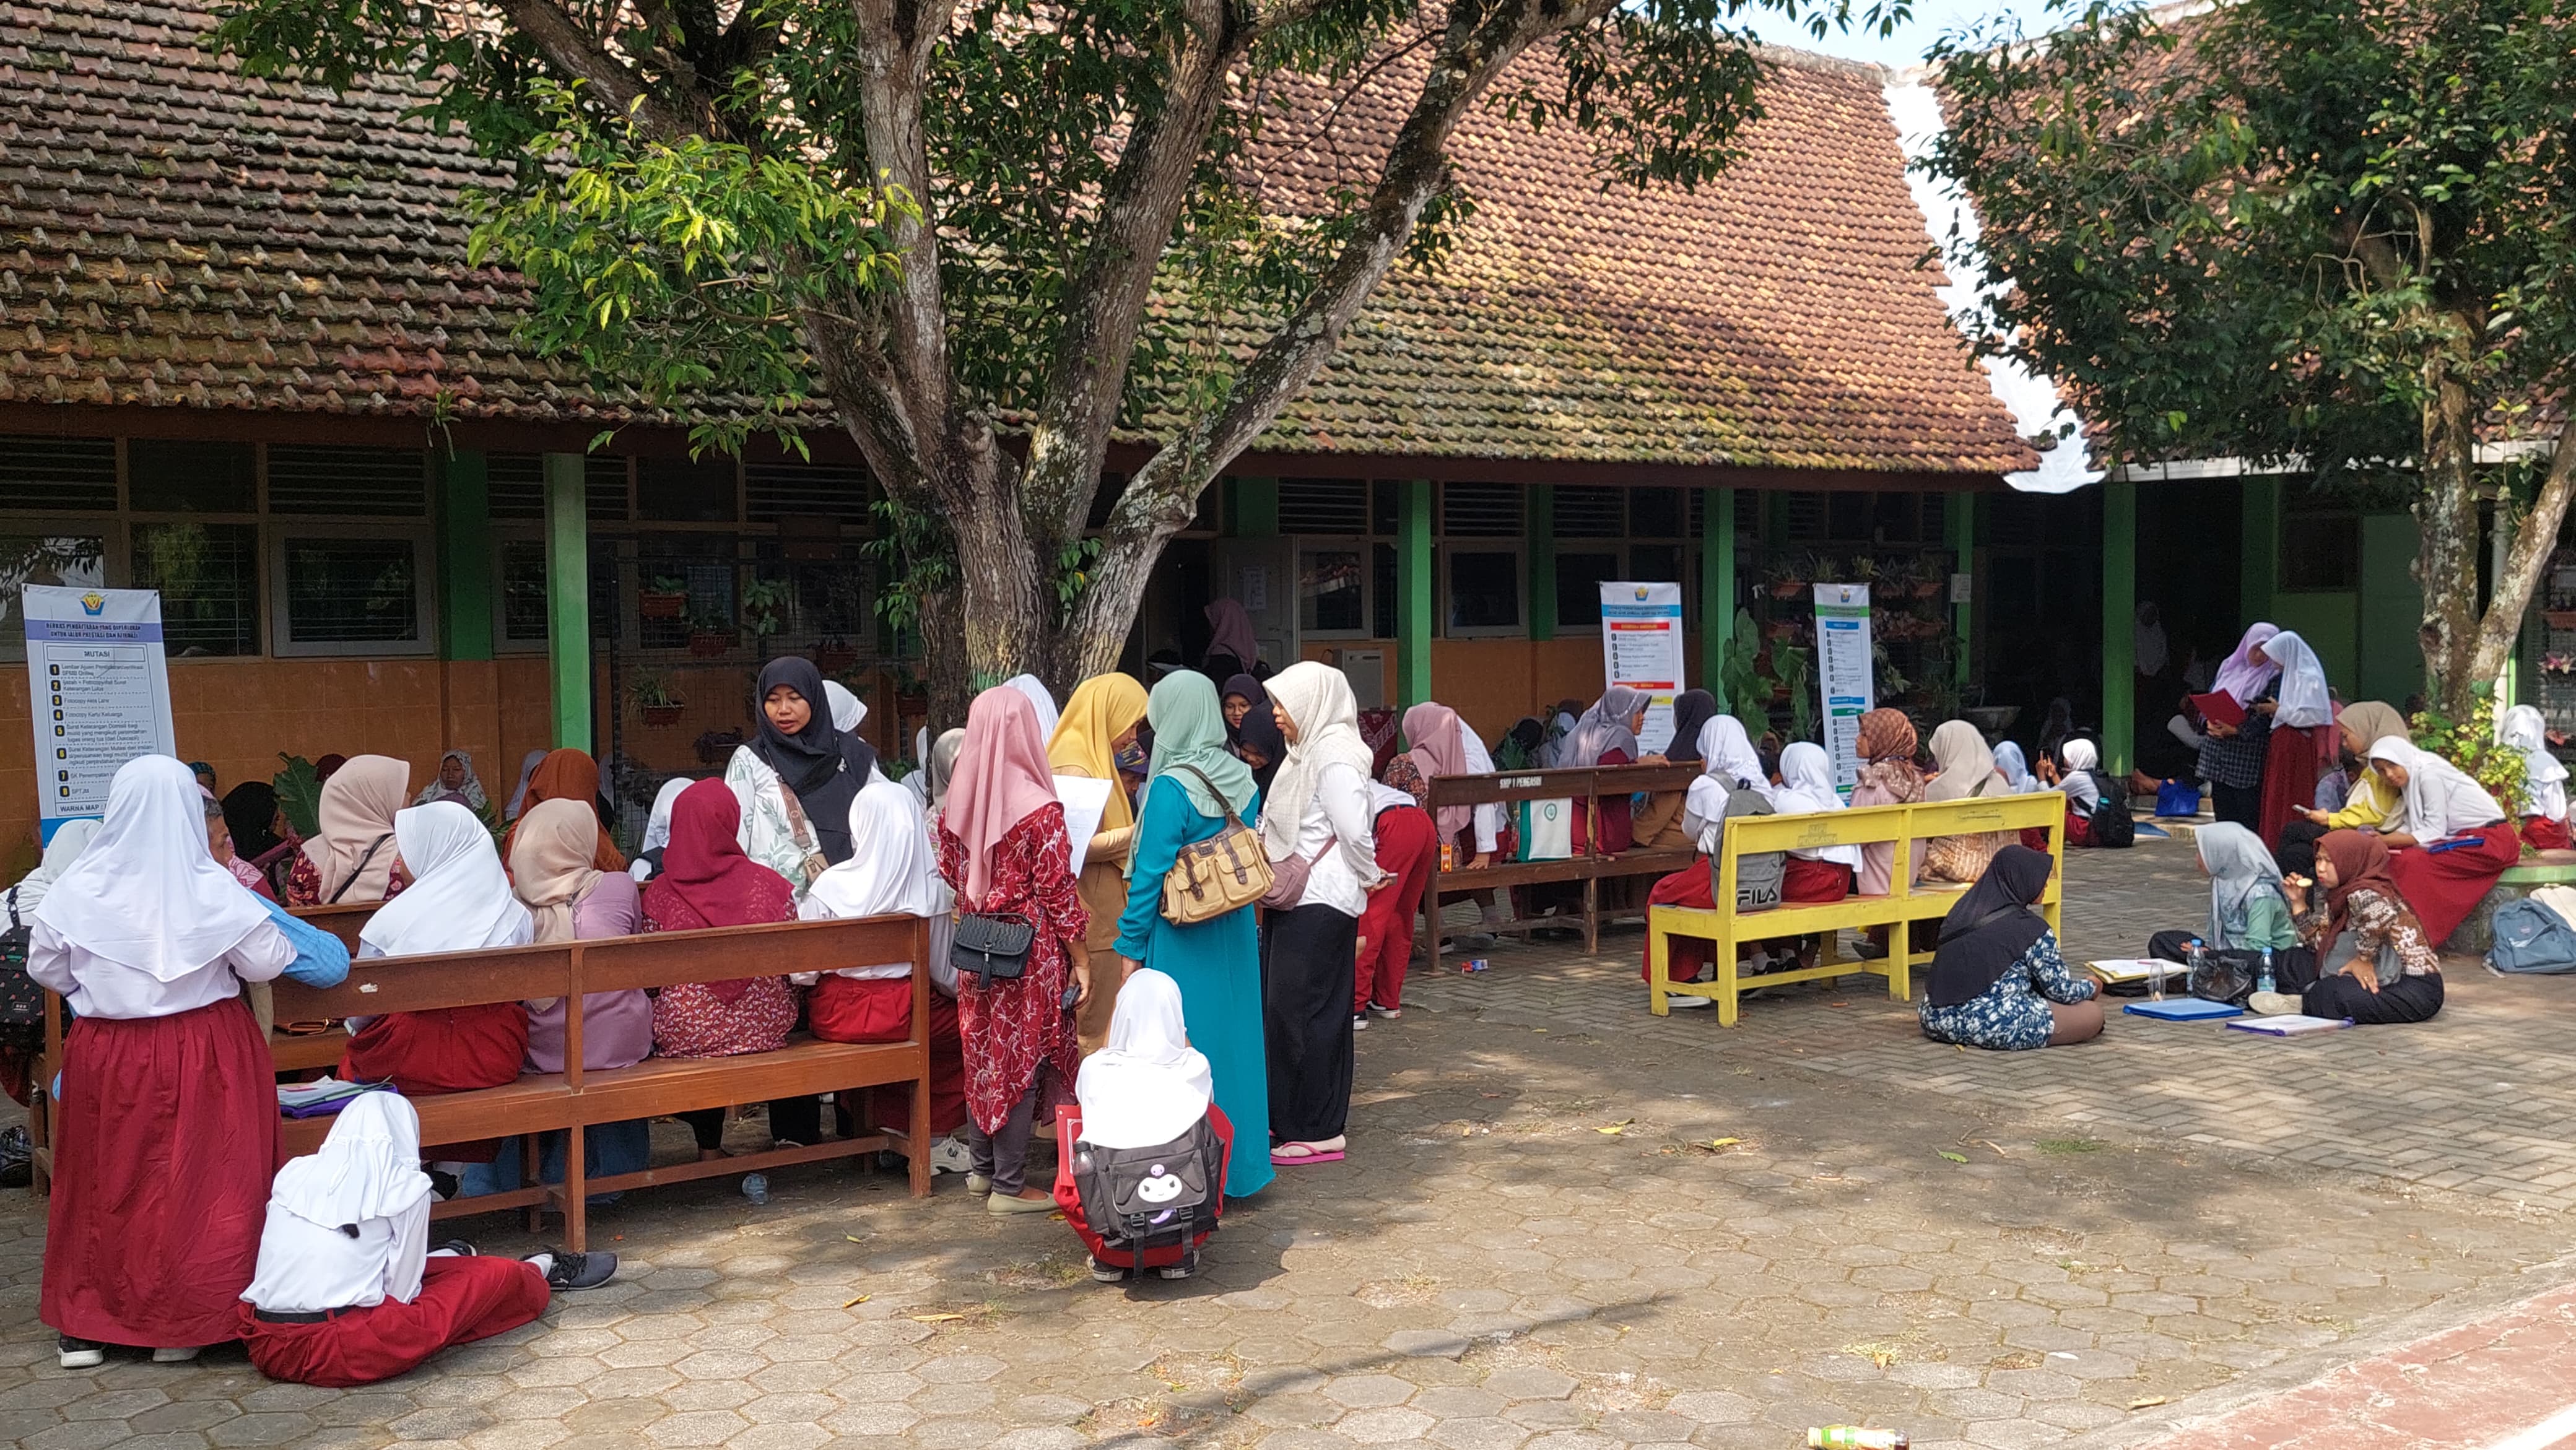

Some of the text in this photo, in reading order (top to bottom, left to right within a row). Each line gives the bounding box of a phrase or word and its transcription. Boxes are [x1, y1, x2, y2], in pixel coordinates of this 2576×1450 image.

[53, 666, 57, 674] 1
[53, 682, 58, 690] 2
[54, 697, 59, 705] 3
[56, 711, 61, 719] 4
[58, 727, 63, 735] 5
[59, 750, 64, 758] 6
[61, 772, 66, 780] 7
[1499, 777, 1512, 789] SMP
[63, 788, 68, 796] 8
[1736, 886, 1778, 906] FILA
